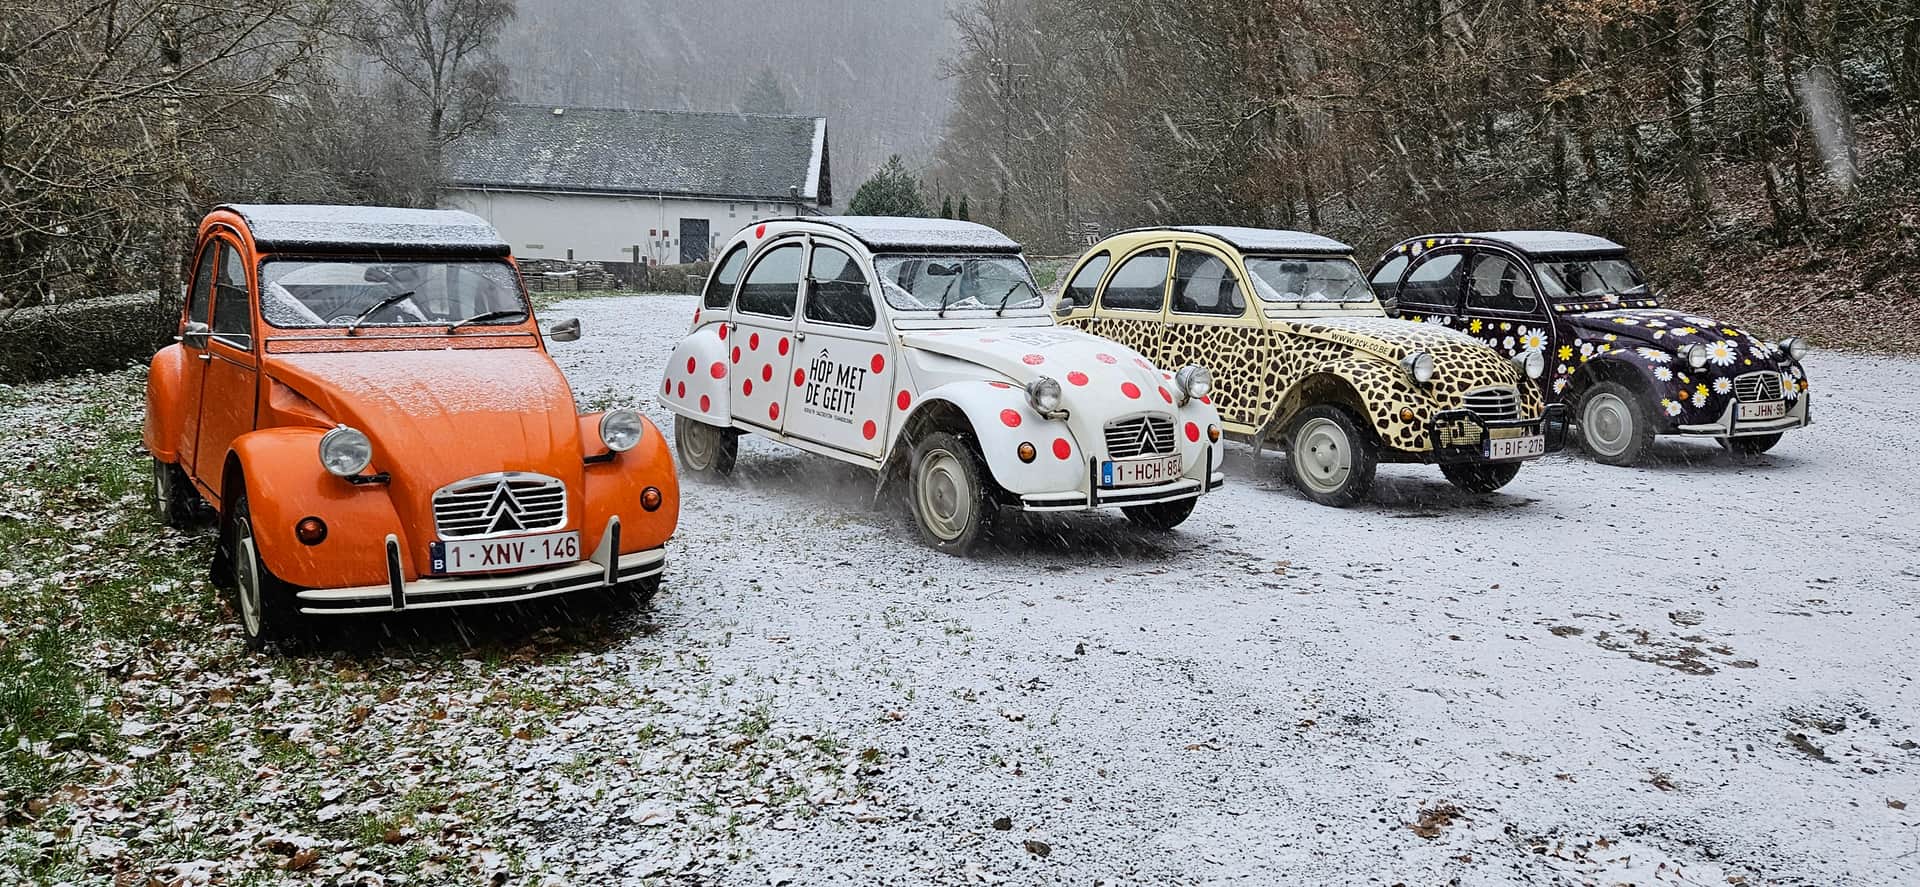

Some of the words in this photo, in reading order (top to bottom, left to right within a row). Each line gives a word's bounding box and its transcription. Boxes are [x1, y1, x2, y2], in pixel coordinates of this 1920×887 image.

[809, 358, 834, 383] HOP
[836, 363, 867, 392] MET
[805, 382, 820, 406] DE
[823, 387, 855, 415] GEIT!
[434, 559, 444, 570] B
